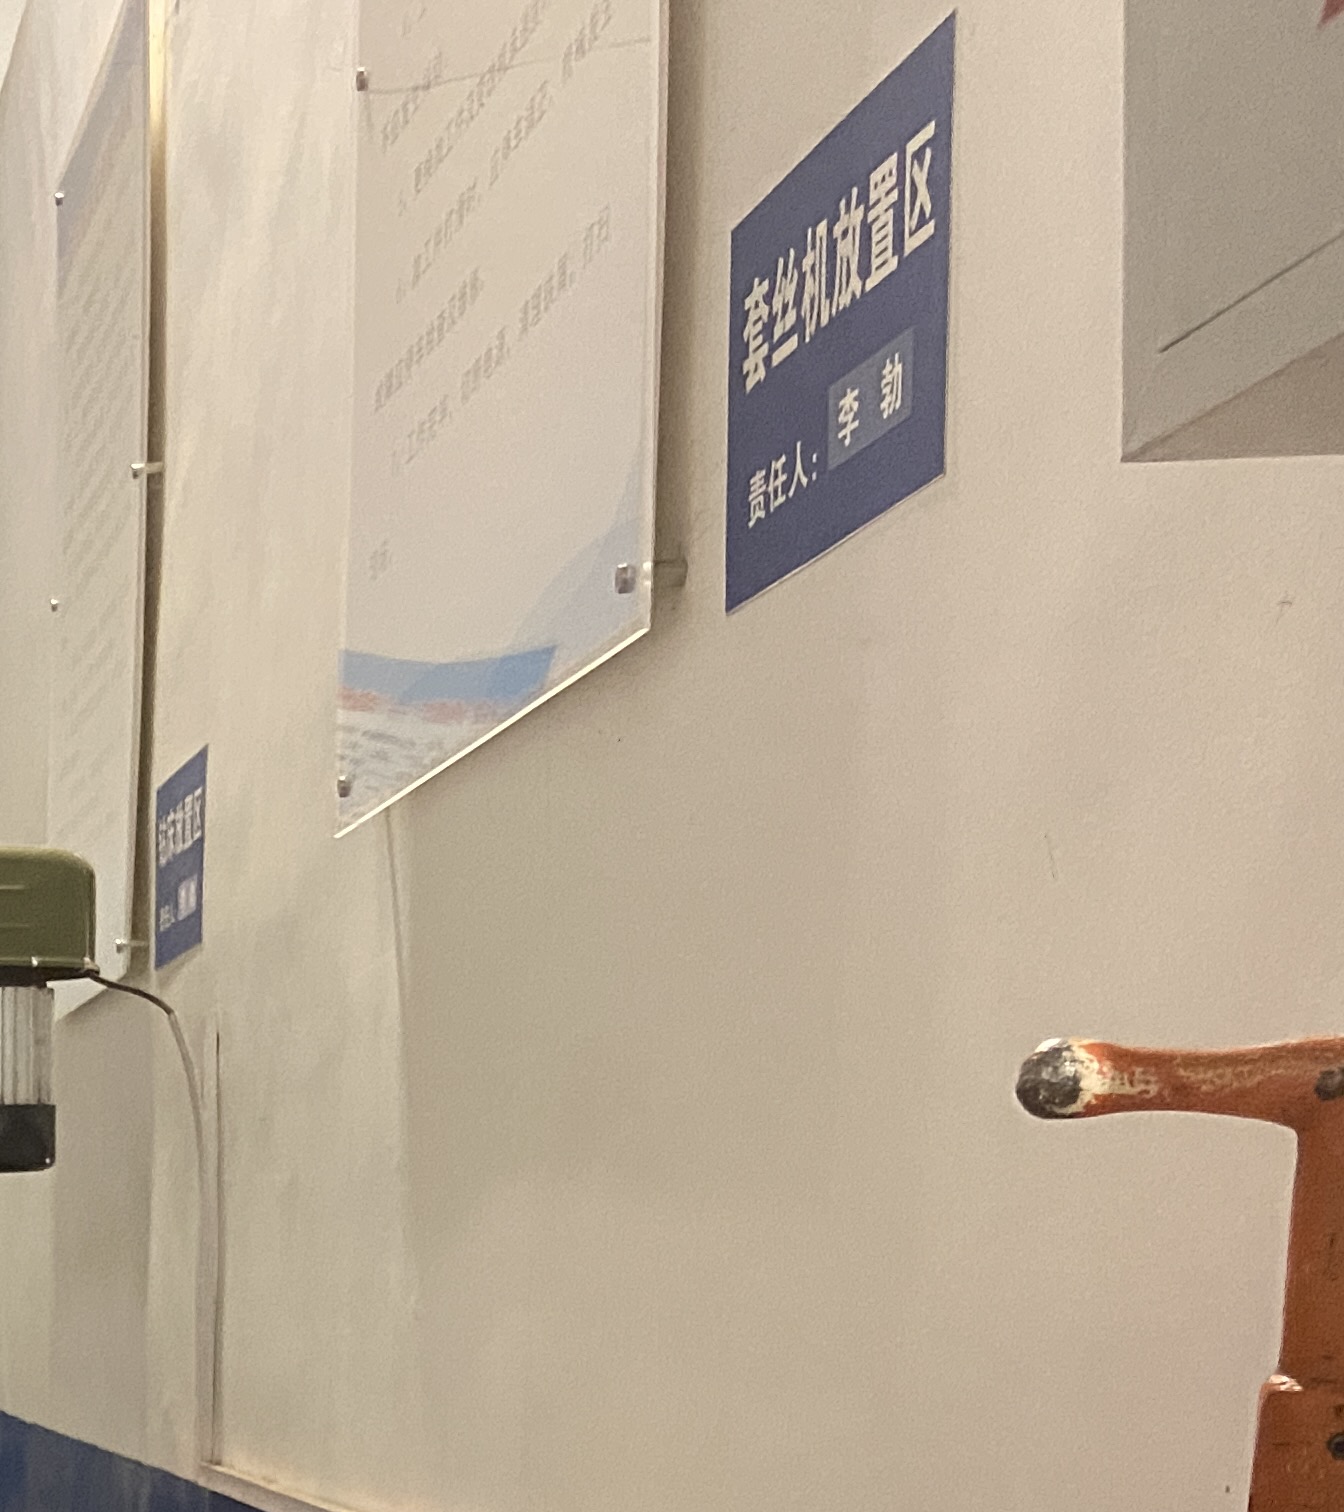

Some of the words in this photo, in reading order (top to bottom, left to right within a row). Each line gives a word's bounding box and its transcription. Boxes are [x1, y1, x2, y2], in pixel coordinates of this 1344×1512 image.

[742, 120, 936, 395] 套丝机放置区
[747, 441, 817, 528] 责任人：
